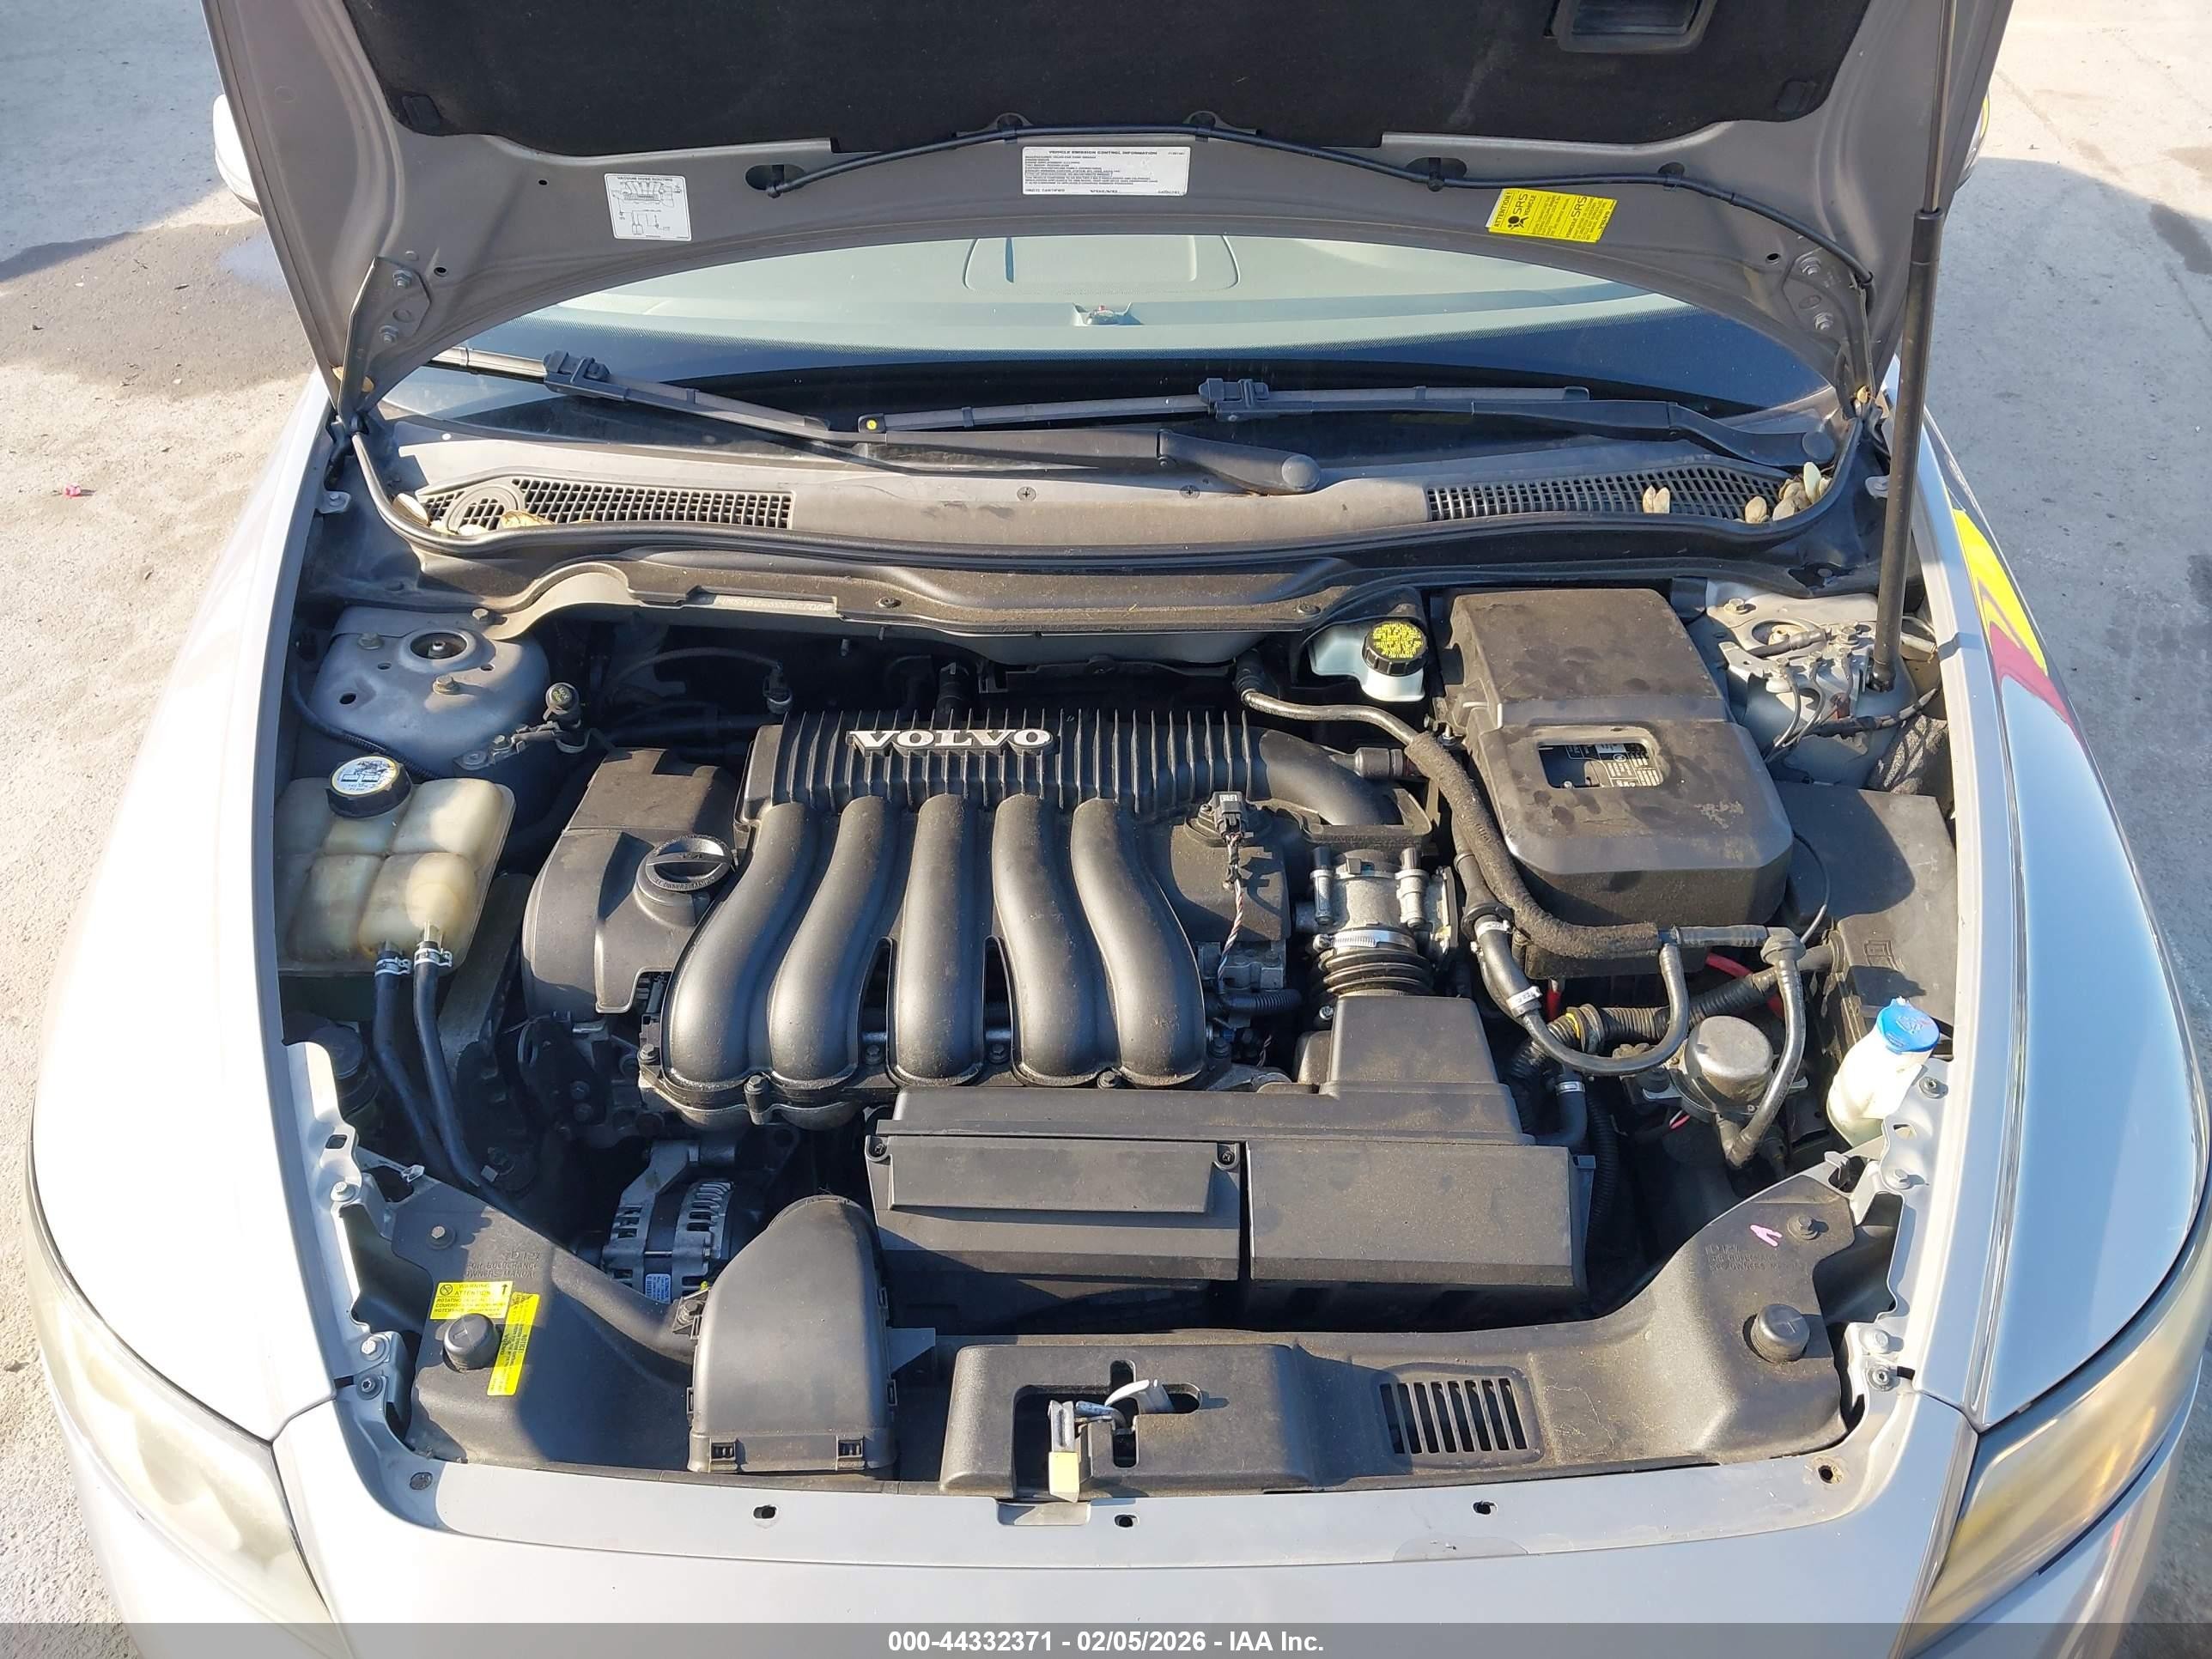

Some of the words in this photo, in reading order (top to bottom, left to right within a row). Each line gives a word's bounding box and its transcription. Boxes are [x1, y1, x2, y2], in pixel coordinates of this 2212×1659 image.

[1494, 191, 1512, 228] ATTENTION!
[1513, 193, 1528, 215] SRS
[1524, 195, 1536, 216] VEHICLE
[1571, 197, 1588, 218] SRS
[849, 728, 1052, 748] VOLVO
